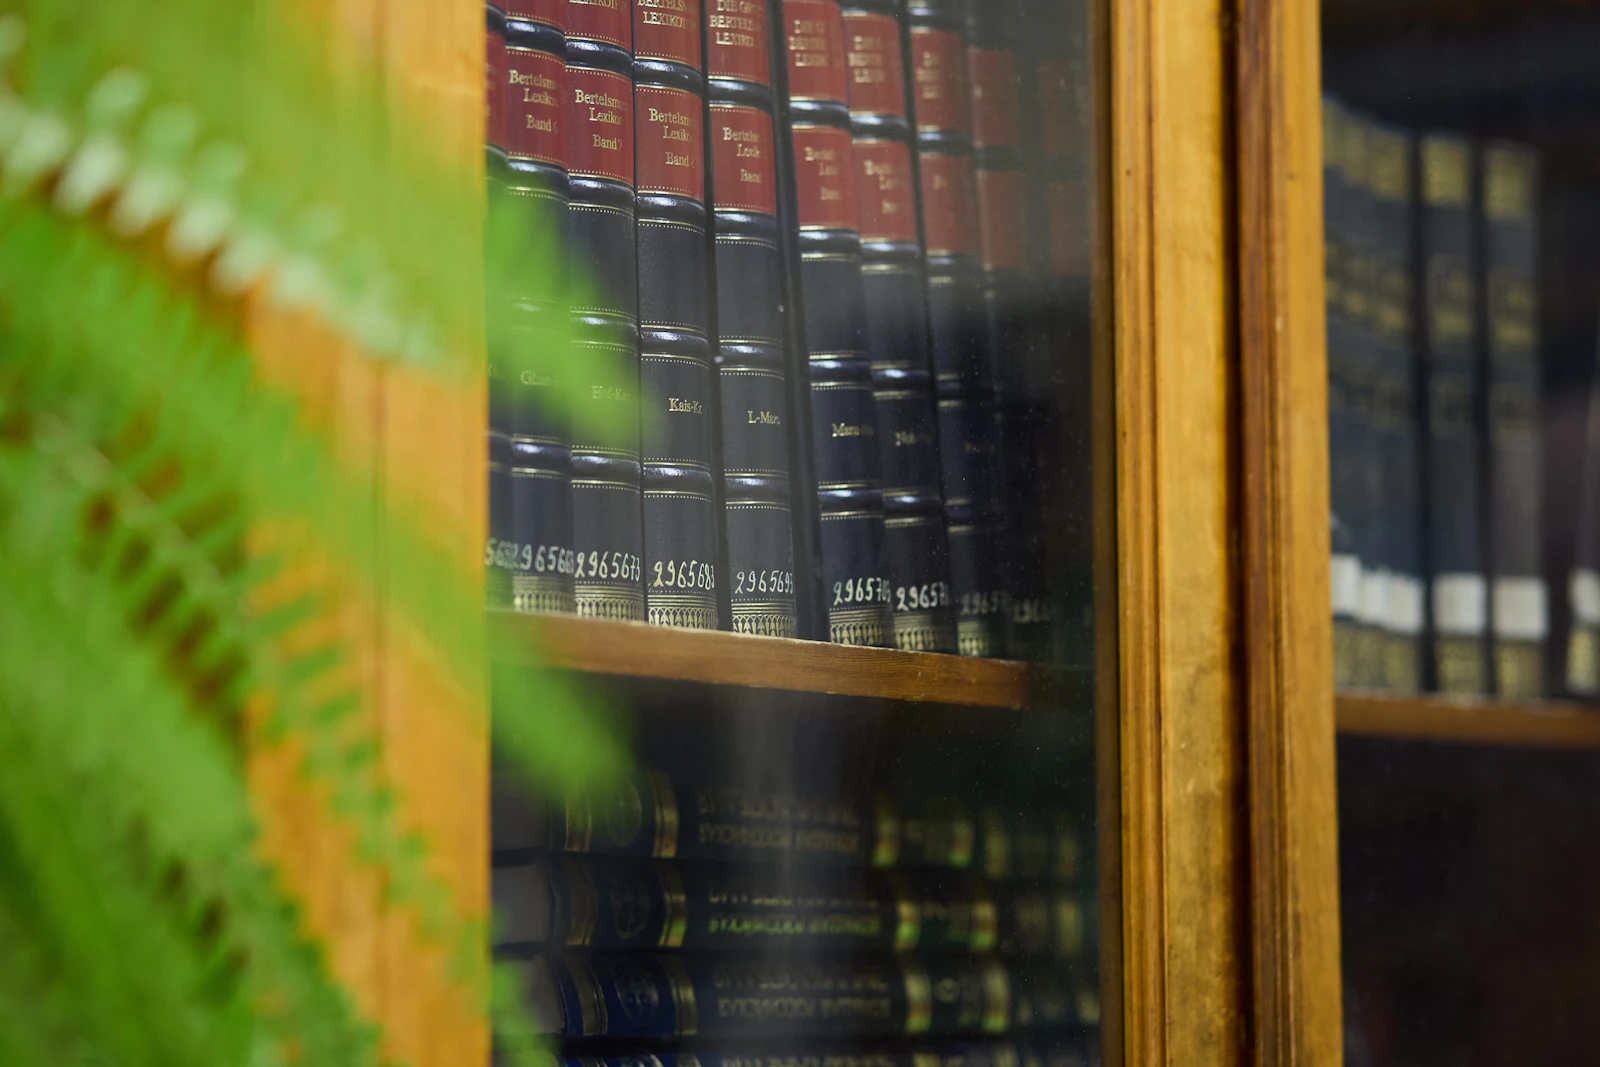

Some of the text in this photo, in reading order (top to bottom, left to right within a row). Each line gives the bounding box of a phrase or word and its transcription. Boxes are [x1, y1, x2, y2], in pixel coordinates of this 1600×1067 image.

[526, 114, 552, 132] Band
[592, 134, 617, 150] Band
[665, 151, 690, 168] Band
[574, 551, 641, 582] 2965673
[895, 581, 949, 612] 29657
